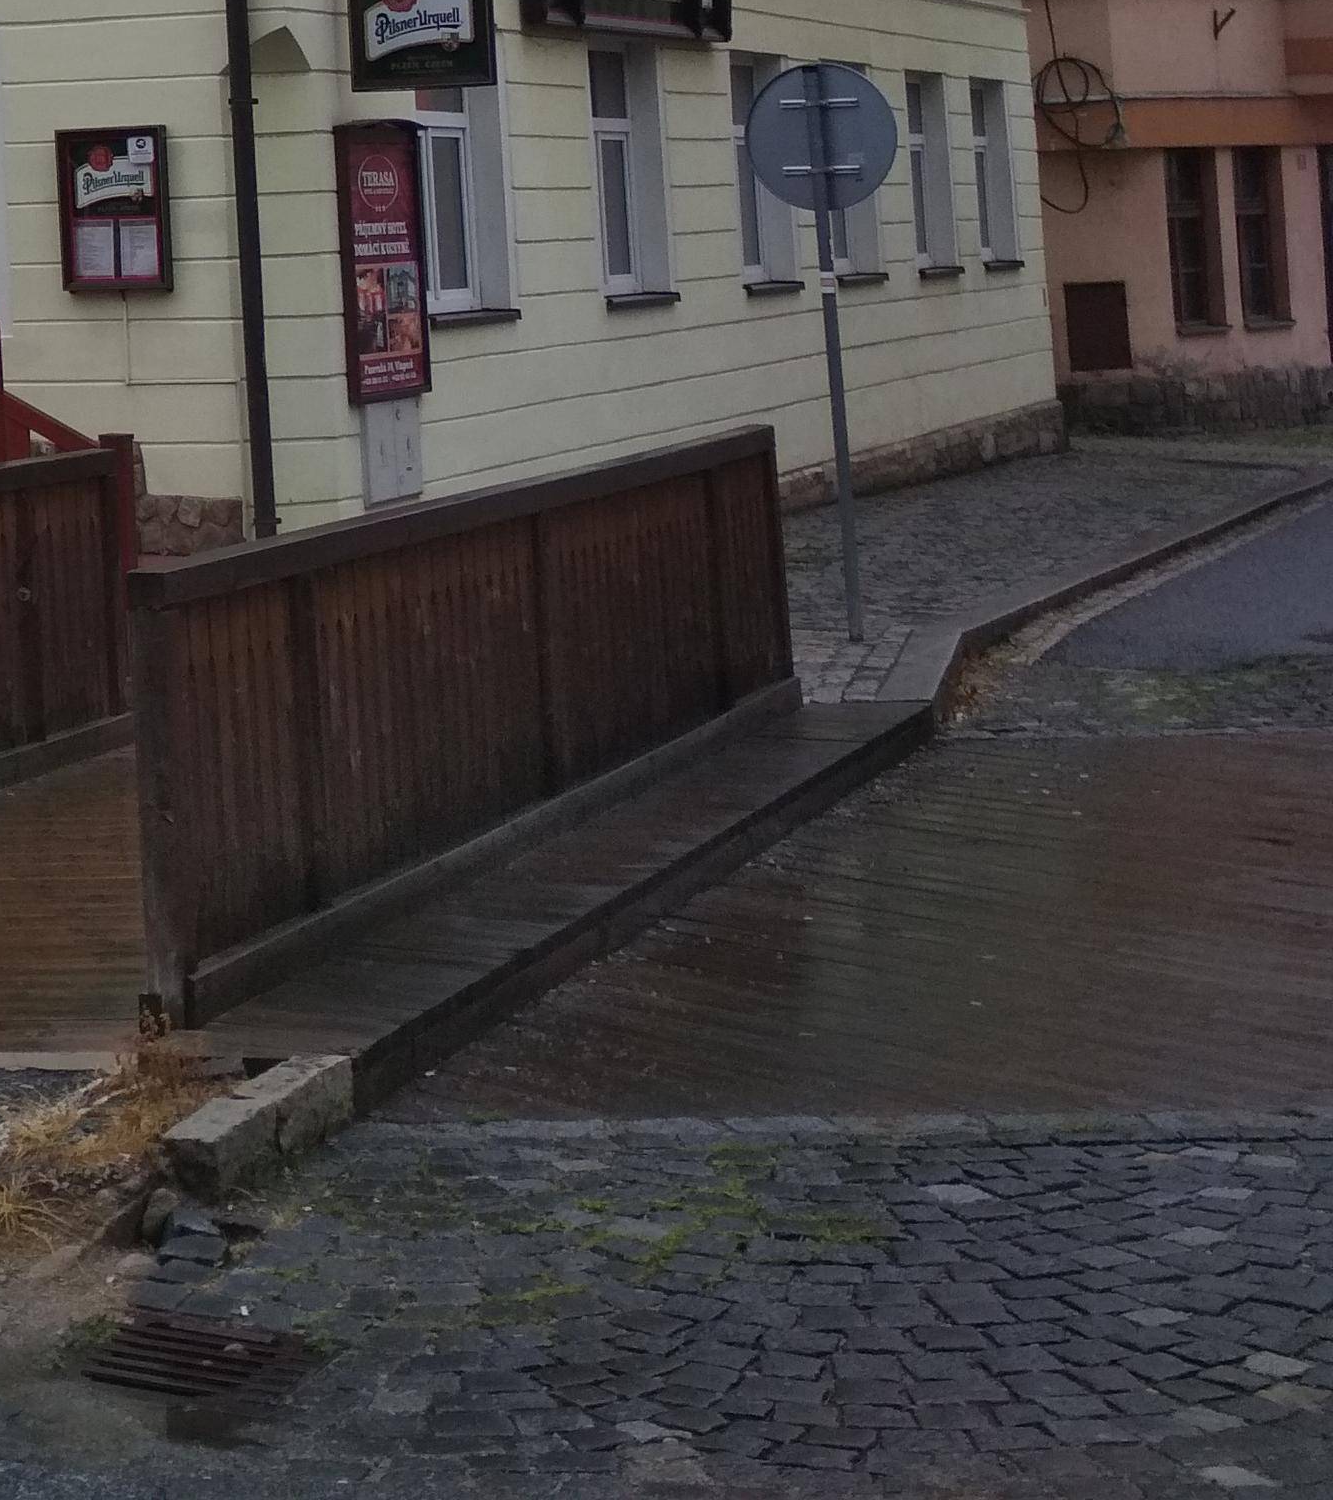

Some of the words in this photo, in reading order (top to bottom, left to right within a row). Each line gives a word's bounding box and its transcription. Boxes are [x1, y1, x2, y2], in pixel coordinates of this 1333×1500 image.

[374, 12, 419, 45] Pilsner
[417, 7, 460, 31] Urquell
[82, 172, 114, 196] Pilsner
[112, 170, 144, 187] Urquell
[361, 171, 395, 187] TERASA
